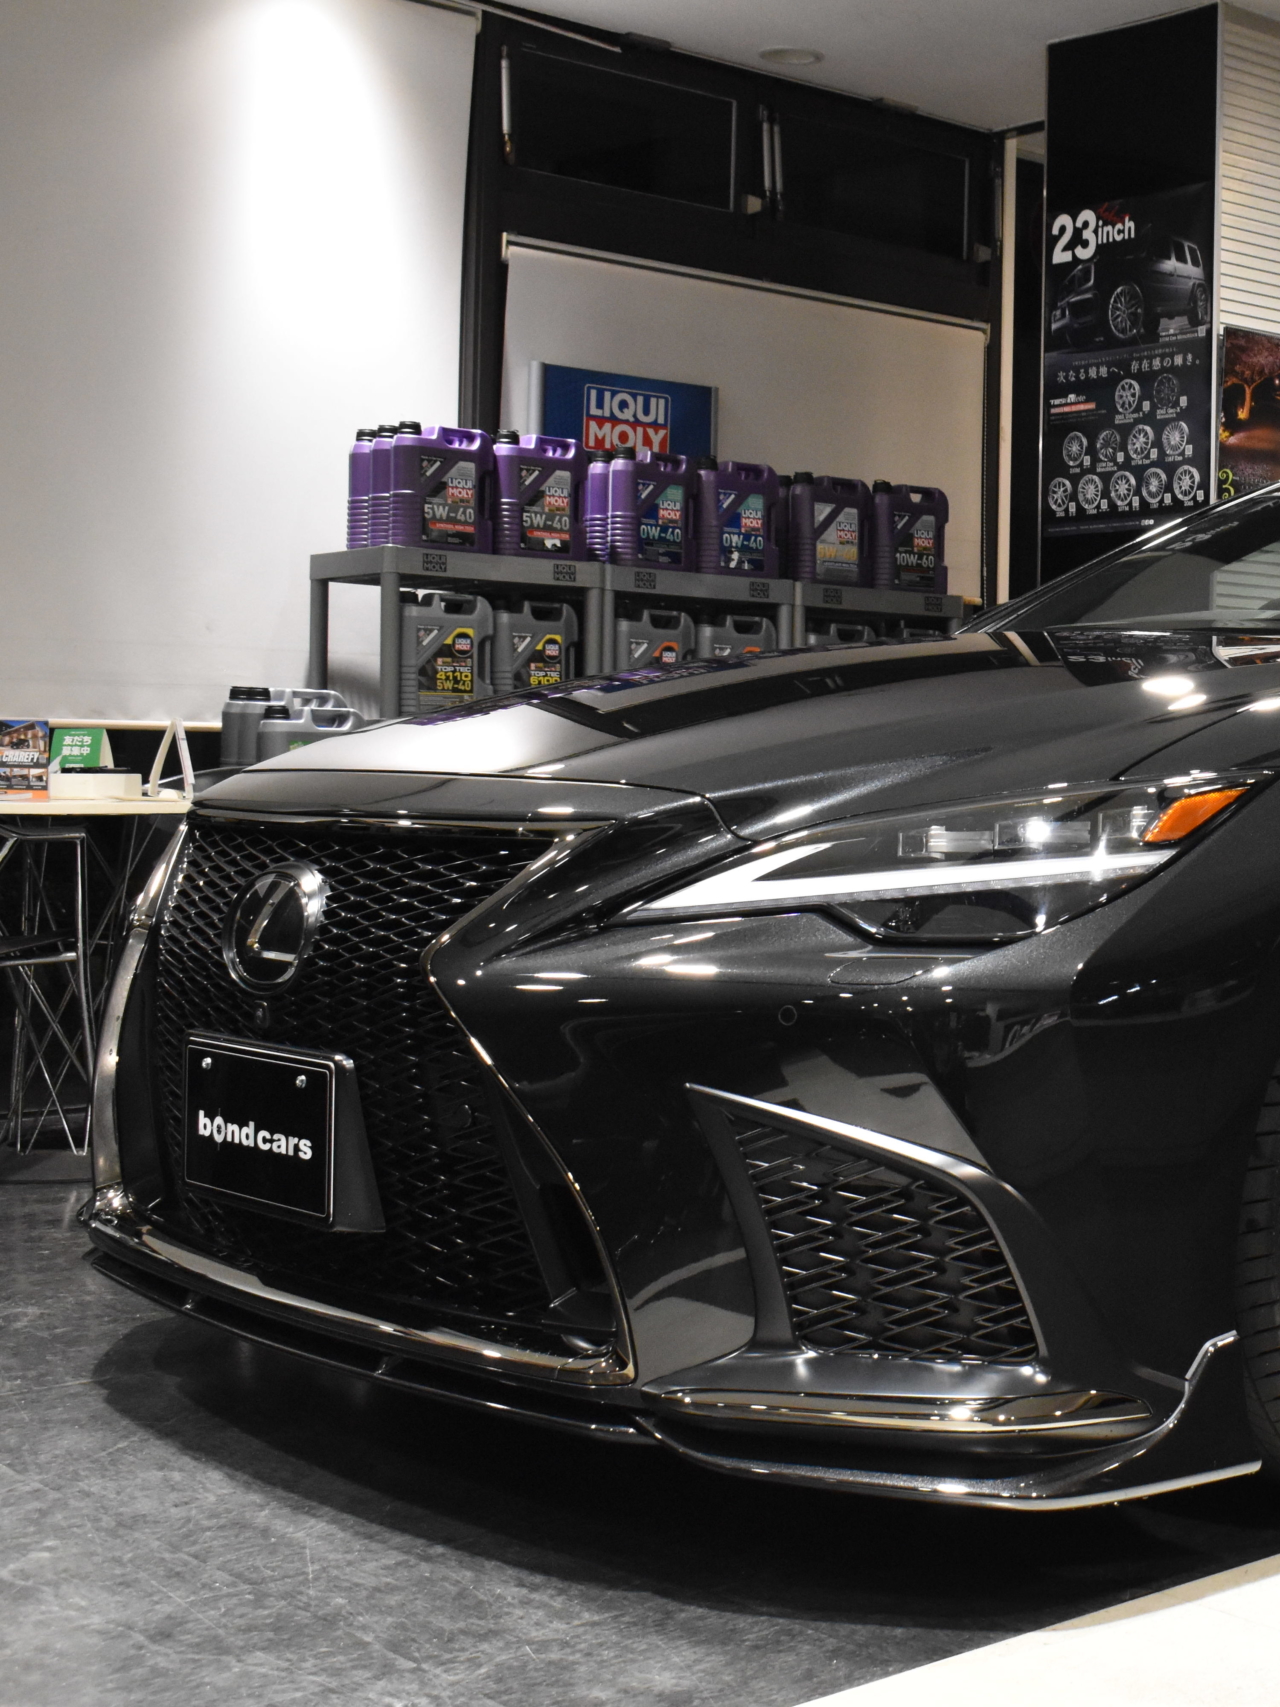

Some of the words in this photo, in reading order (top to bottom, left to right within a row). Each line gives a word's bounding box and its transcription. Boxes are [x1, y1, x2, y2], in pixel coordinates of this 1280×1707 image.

[589, 388, 666, 425] LIQUI
[588, 420, 668, 453] MOLY
[448, 477, 473, 488] LIQUI
[448, 489, 473, 499] MOLY
[546, 486, 568, 497] LIQUI
[546, 497, 569, 507] MOLY
[659, 500, 681, 510] LIQUI
[424, 503, 475, 523] 5W-40
[659, 509, 682, 519] MOLY
[741, 510, 762, 519] LIQUI
[522, 513, 570, 531] 5W-40
[741, 518, 763, 528] MOLY
[837, 522, 856, 531] LIQUI
[640, 525, 682, 543] 0W-40
[837, 531, 857, 541] MOLY
[914, 529, 933, 539] LIQUI
[723, 533, 764, 550] 0W-40
[914, 538, 934, 547] MOLY
[895, 553, 935, 568] 10W-60
[554, 564, 576, 573] LIQUI
[554, 572, 576, 582] MOLY
[454, 637, 471, 645] LIQUI
[436, 672, 472, 681] 4110
[436, 680, 472, 690] 5W-40
[62, 735, 93, 745] 友だち
